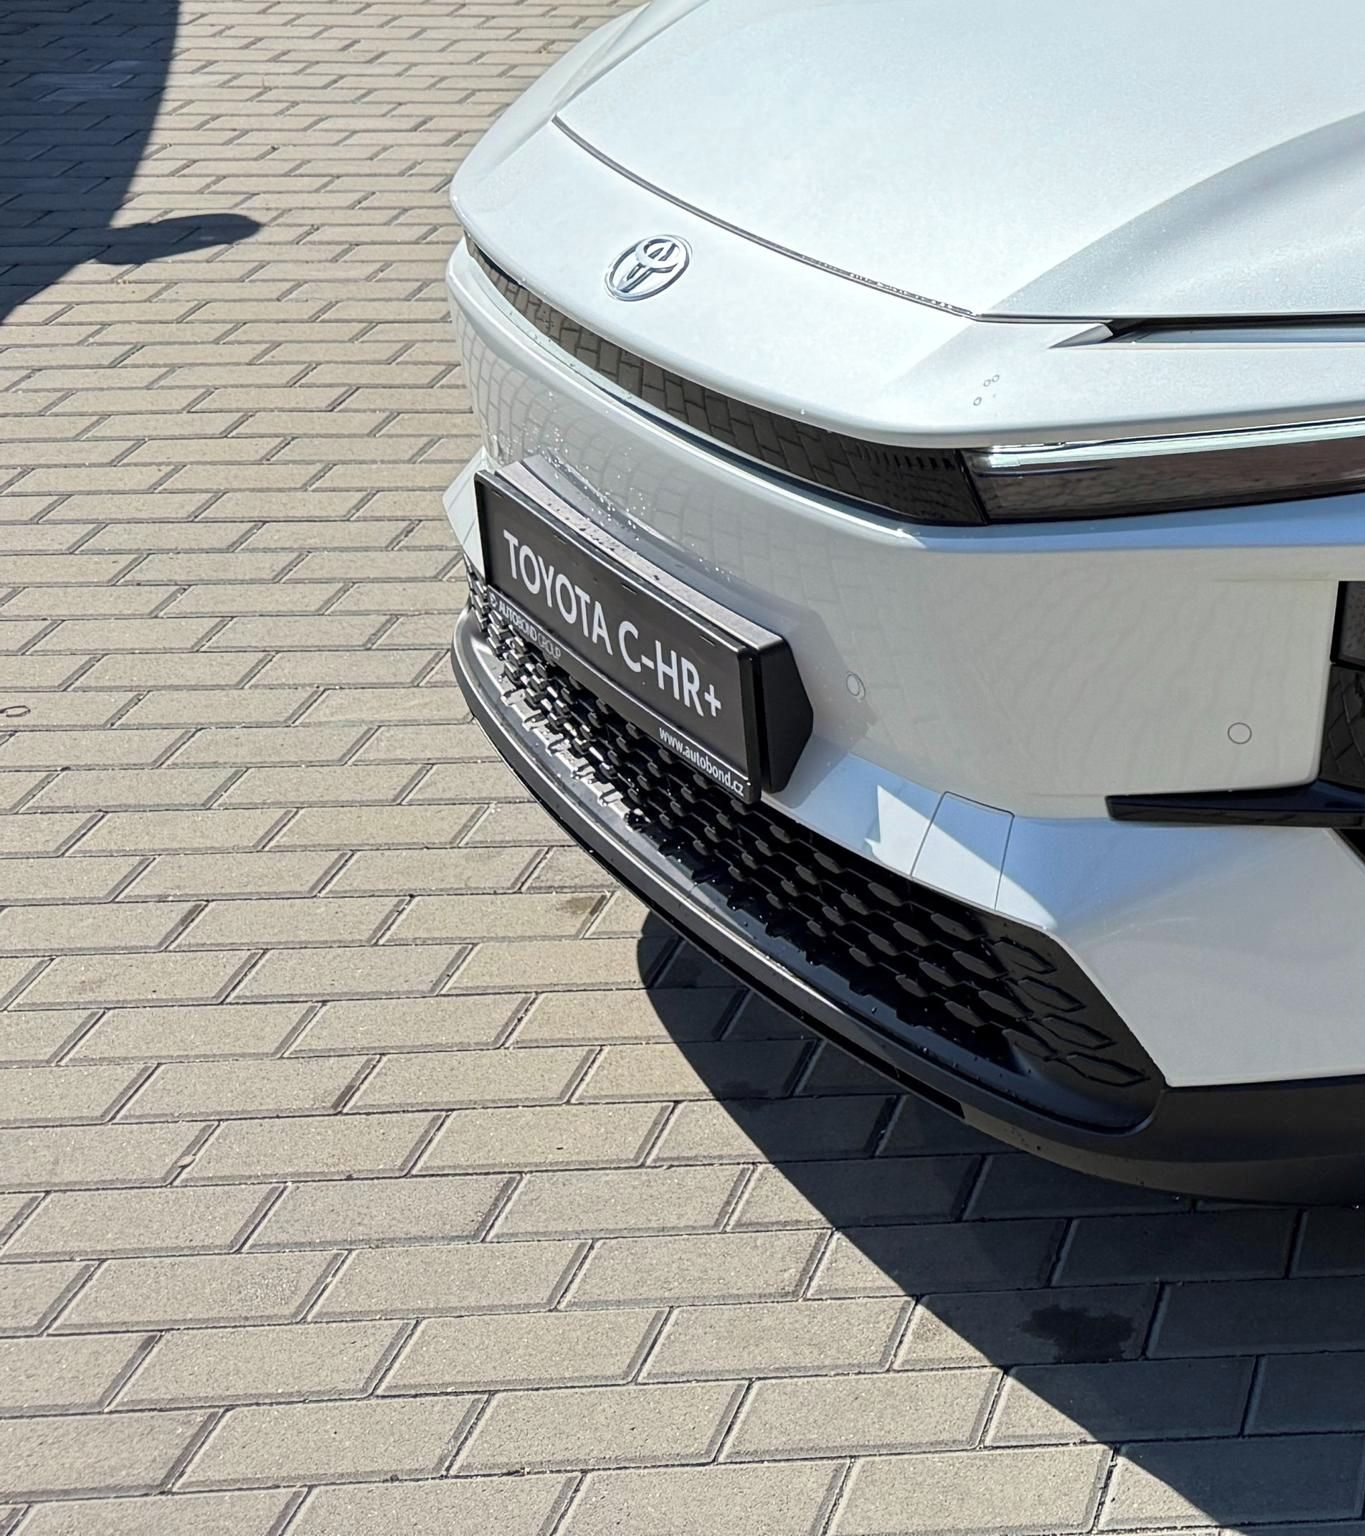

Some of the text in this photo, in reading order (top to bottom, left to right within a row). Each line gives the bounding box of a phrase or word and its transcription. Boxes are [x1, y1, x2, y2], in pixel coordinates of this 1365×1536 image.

[498, 600, 562, 661] AUTOBOND GROUP
[503, 529, 722, 718] TOYOTA C-HR+
[658, 726, 745, 798] www.autobond.cz
